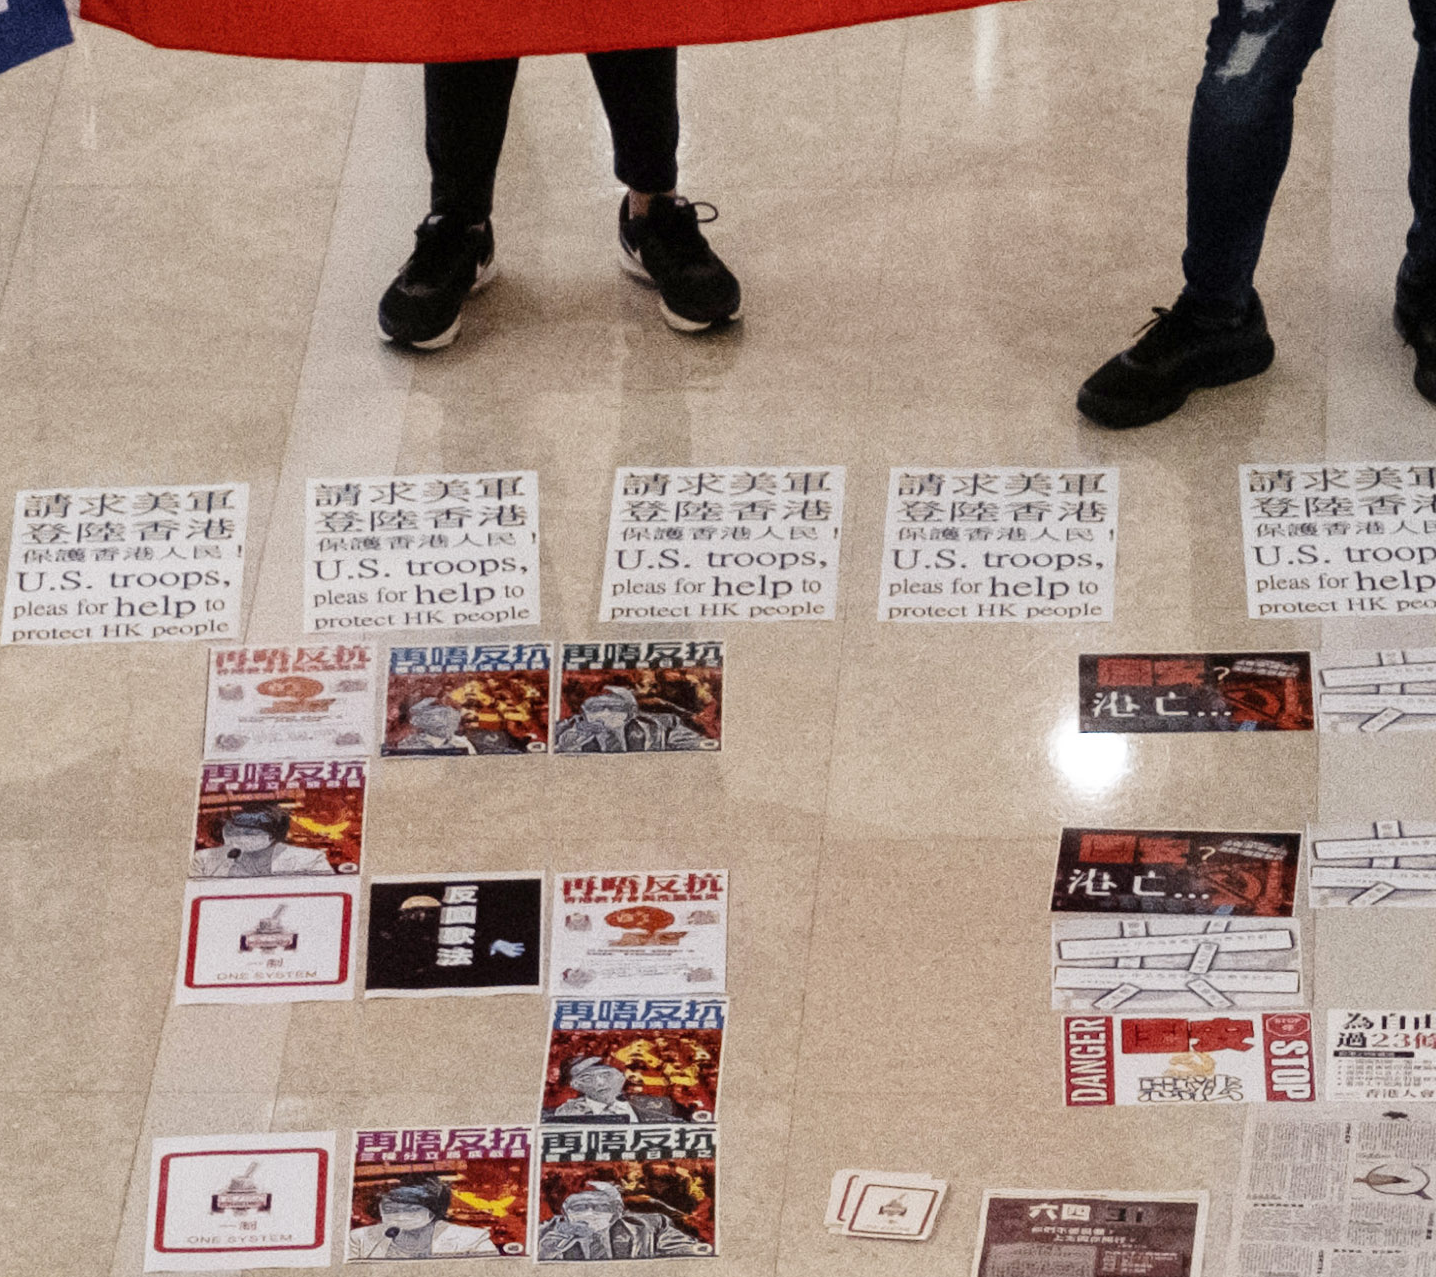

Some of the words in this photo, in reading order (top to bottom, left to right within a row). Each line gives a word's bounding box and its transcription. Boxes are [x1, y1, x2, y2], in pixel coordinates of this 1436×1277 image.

[314, 476, 526, 507] 請求美軍
[622, 471, 831, 497] 請求美軍
[898, 471, 1107, 497] 請求美軍
[24, 491, 237, 519] 請求美軍
[621, 500, 832, 523] 登陸香港
[898, 500, 1109, 523] 登陸香港
[21, 519, 237, 544] 登陸香港
[318, 505, 528, 535] 登陸香港
[313, 559, 390, 581] U.S.
[407, 555, 528, 577] troops,
[615, 549, 691, 570] U.S.
[707, 547, 828, 570] troops,
[892, 549, 967, 570] U.S.
[984, 547, 1104, 571] troops,
[1254, 545, 1331, 567] U.S.
[17, 571, 93, 592] U.S.
[110, 569, 230, 591] troops,
[612, 578, 666, 597] pleas
[674, 576, 705, 594] for
[711, 575, 793, 599] help
[802, 577, 821, 594] to
[889, 578, 944, 597] pleas
[952, 576, 983, 594] for
[989, 575, 1070, 599] help
[1079, 577, 1099, 595] to
[1256, 576, 1310, 594] pleas
[1317, 573, 1349, 591] for
[1354, 569, 1436, 593] help
[13, 599, 72, 619] pleas
[78, 598, 108, 617] for
[115, 595, 196, 619] help
[205, 596, 225, 613] to
[313, 587, 371, 609] pleas
[378, 585, 409, 605] for
[414, 582, 495, 608] help
[504, 582, 524, 599] to
[1259, 602, 1338, 615] protect
[1348, 597, 1387, 611] HK
[314, 613, 393, 631] protect
[403, 610, 445, 625] HK
[452, 606, 530, 625] people
[610, 604, 688, 621] protect
[699, 602, 739, 616] HK
[748, 601, 825, 618] people
[888, 604, 967, 621] protect
[977, 602, 1017, 617] HK
[1026, 602, 1102, 619] people
[12, 626, 91, 642] protect
[102, 623, 140, 638] HK
[151, 620, 229, 639] people
[1070, 1018, 1107, 1102] DANGER
[1270, 1040, 1311, 1100] STOP
[1029, 1204, 1091, 1221] 六四
